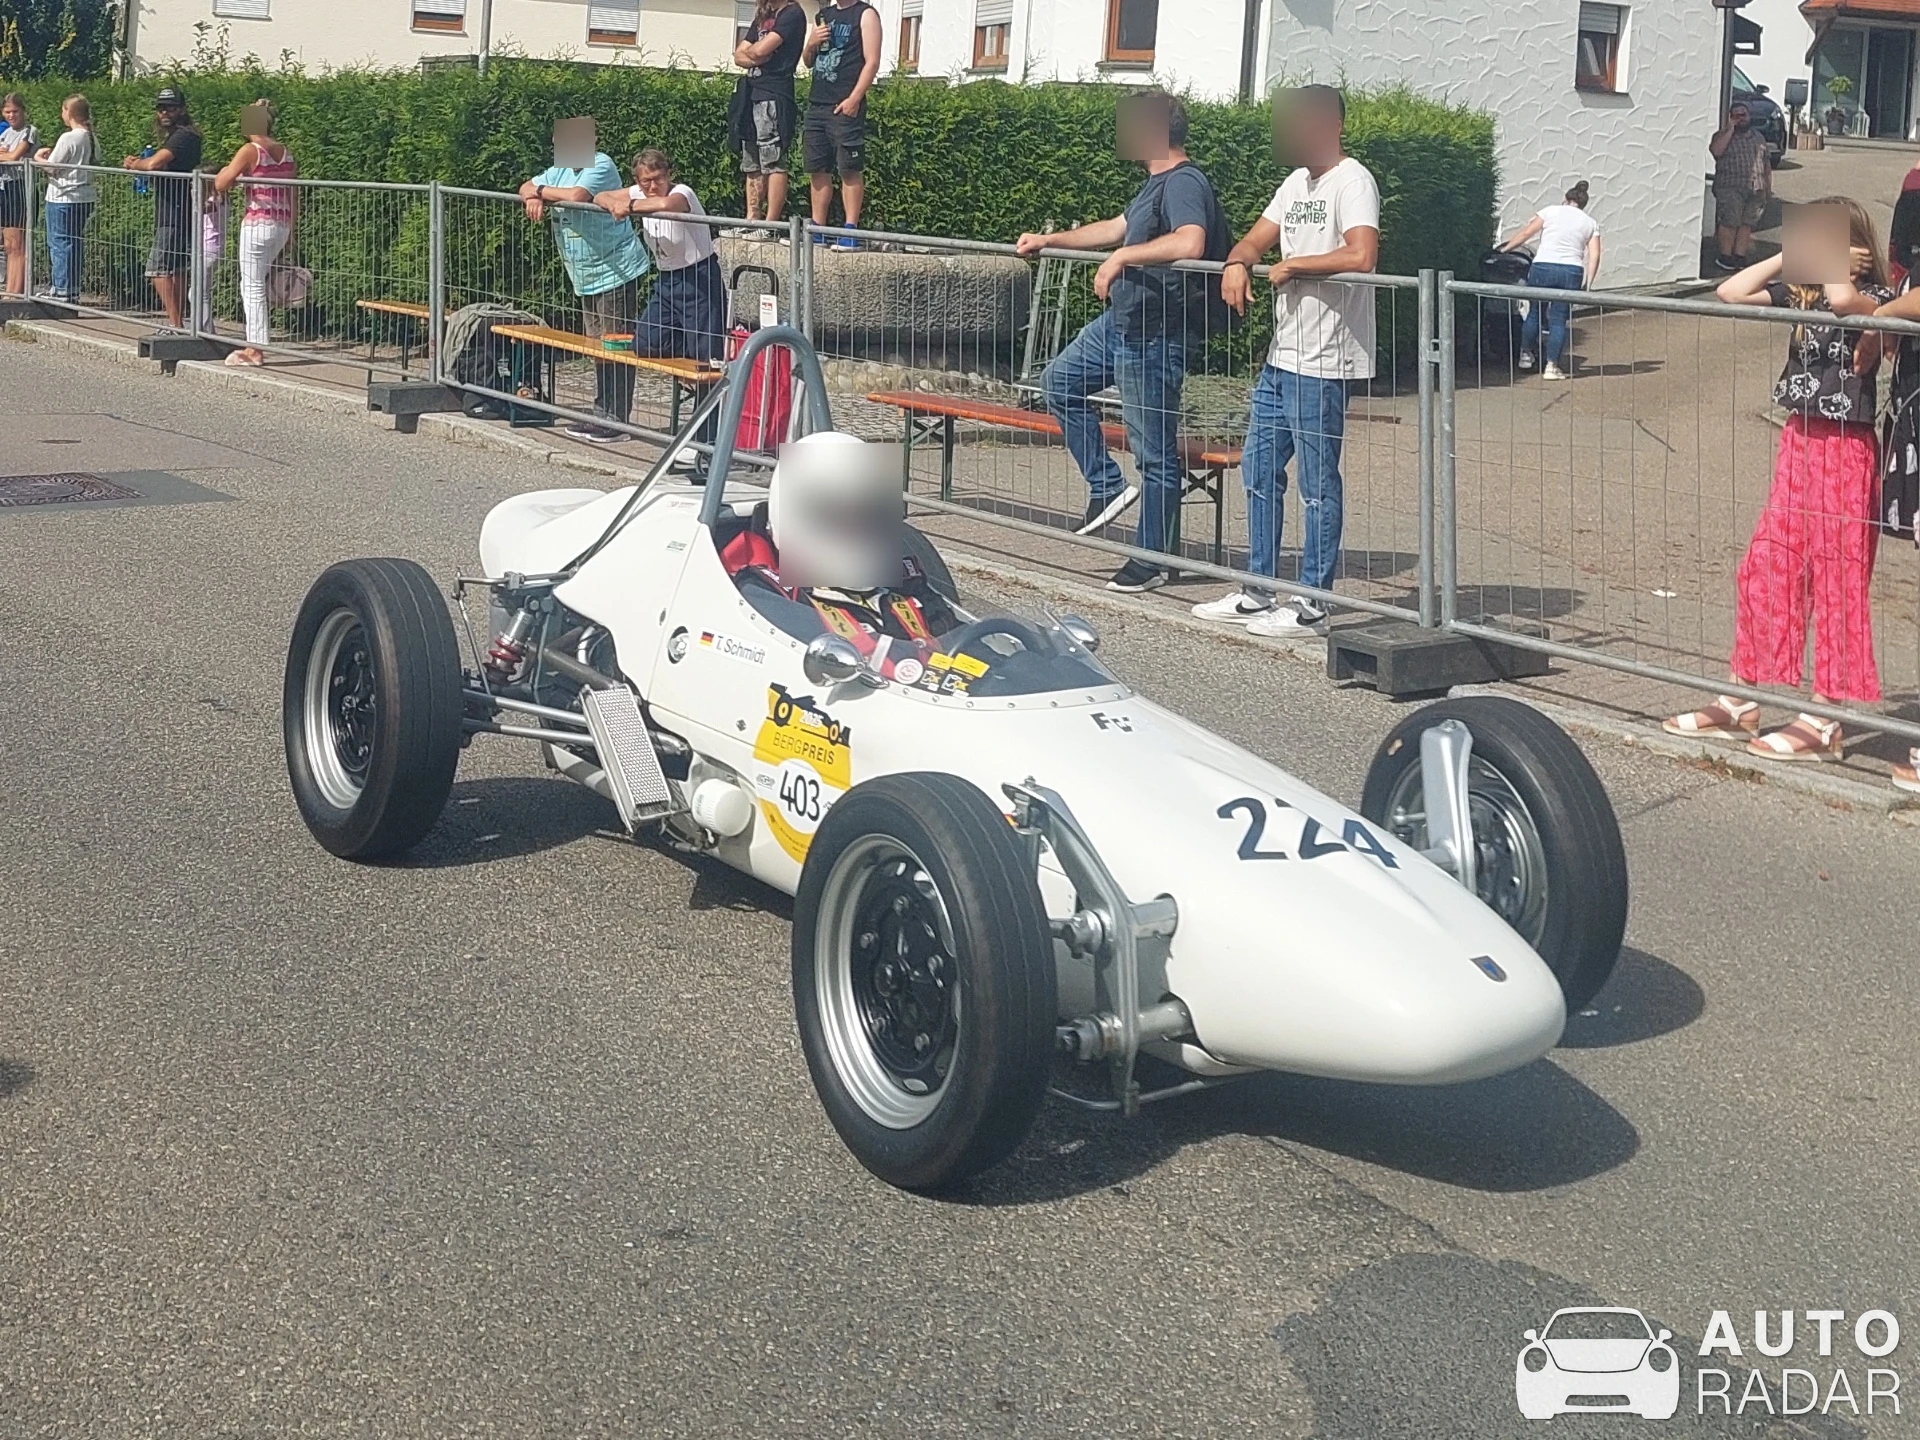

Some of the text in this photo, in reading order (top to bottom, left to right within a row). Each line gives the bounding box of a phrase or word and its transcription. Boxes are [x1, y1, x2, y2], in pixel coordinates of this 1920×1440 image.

[724, 638, 766, 665] Schmidt
[773, 731, 836, 766] BERGPREIS
[780, 769, 820, 822] 403
[1216, 797, 1401, 870] 224
